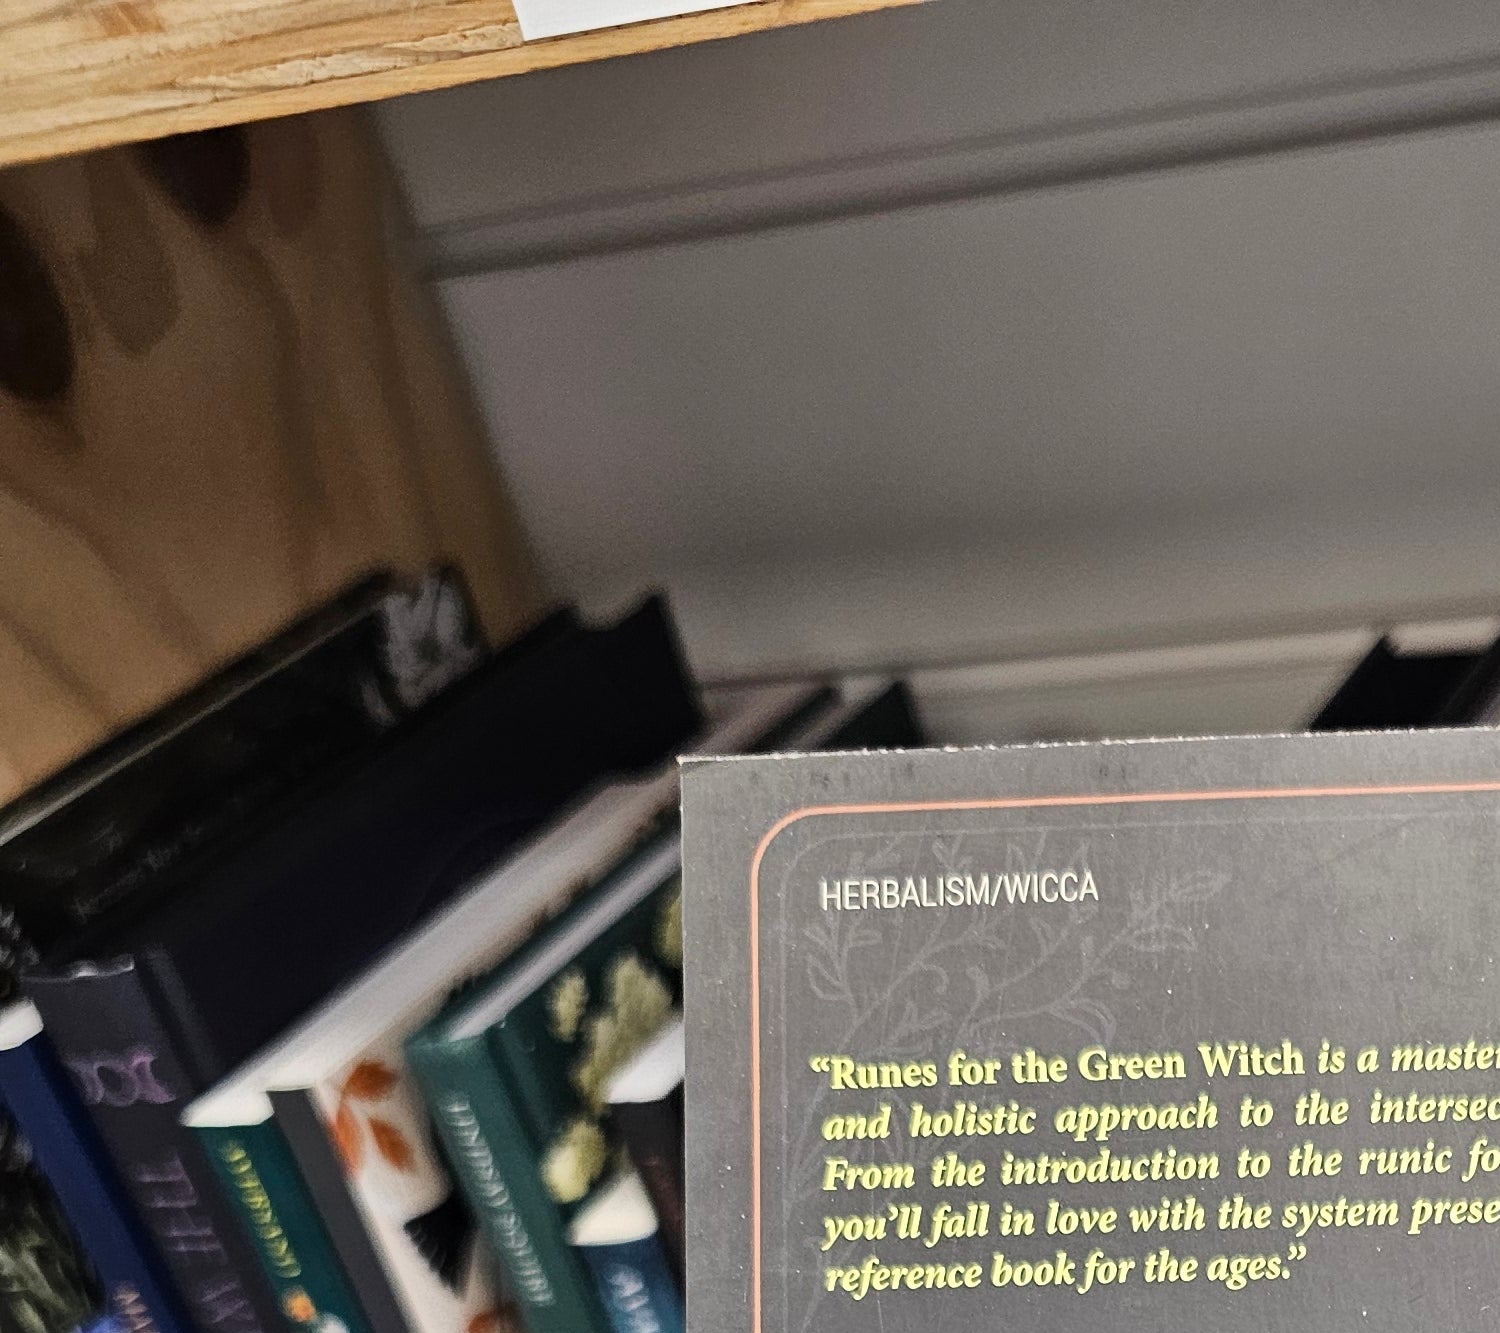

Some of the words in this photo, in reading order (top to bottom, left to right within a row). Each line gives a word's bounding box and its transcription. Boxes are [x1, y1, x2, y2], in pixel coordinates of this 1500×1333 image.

[819, 871, 1100, 912] HERBALISM/WICCA
[810, 1056, 937, 1089] “Runes
[949, 1049, 1001, 1085] for
[1012, 1048, 1067, 1083] the
[1078, 1046, 1186, 1081] Green
[1198, 1039, 1305, 1077] Witch
[1319, 1039, 1345, 1073] is
[1357, 1048, 1379, 1072] a
[824, 1256, 982, 1300] reference
[991, 1247, 1076, 1288] book
[1077, 1256, 1137, 1296] for
[1145, 1247, 1198, 1282] the
[1207, 1243, 1306, 1290] ages.”
